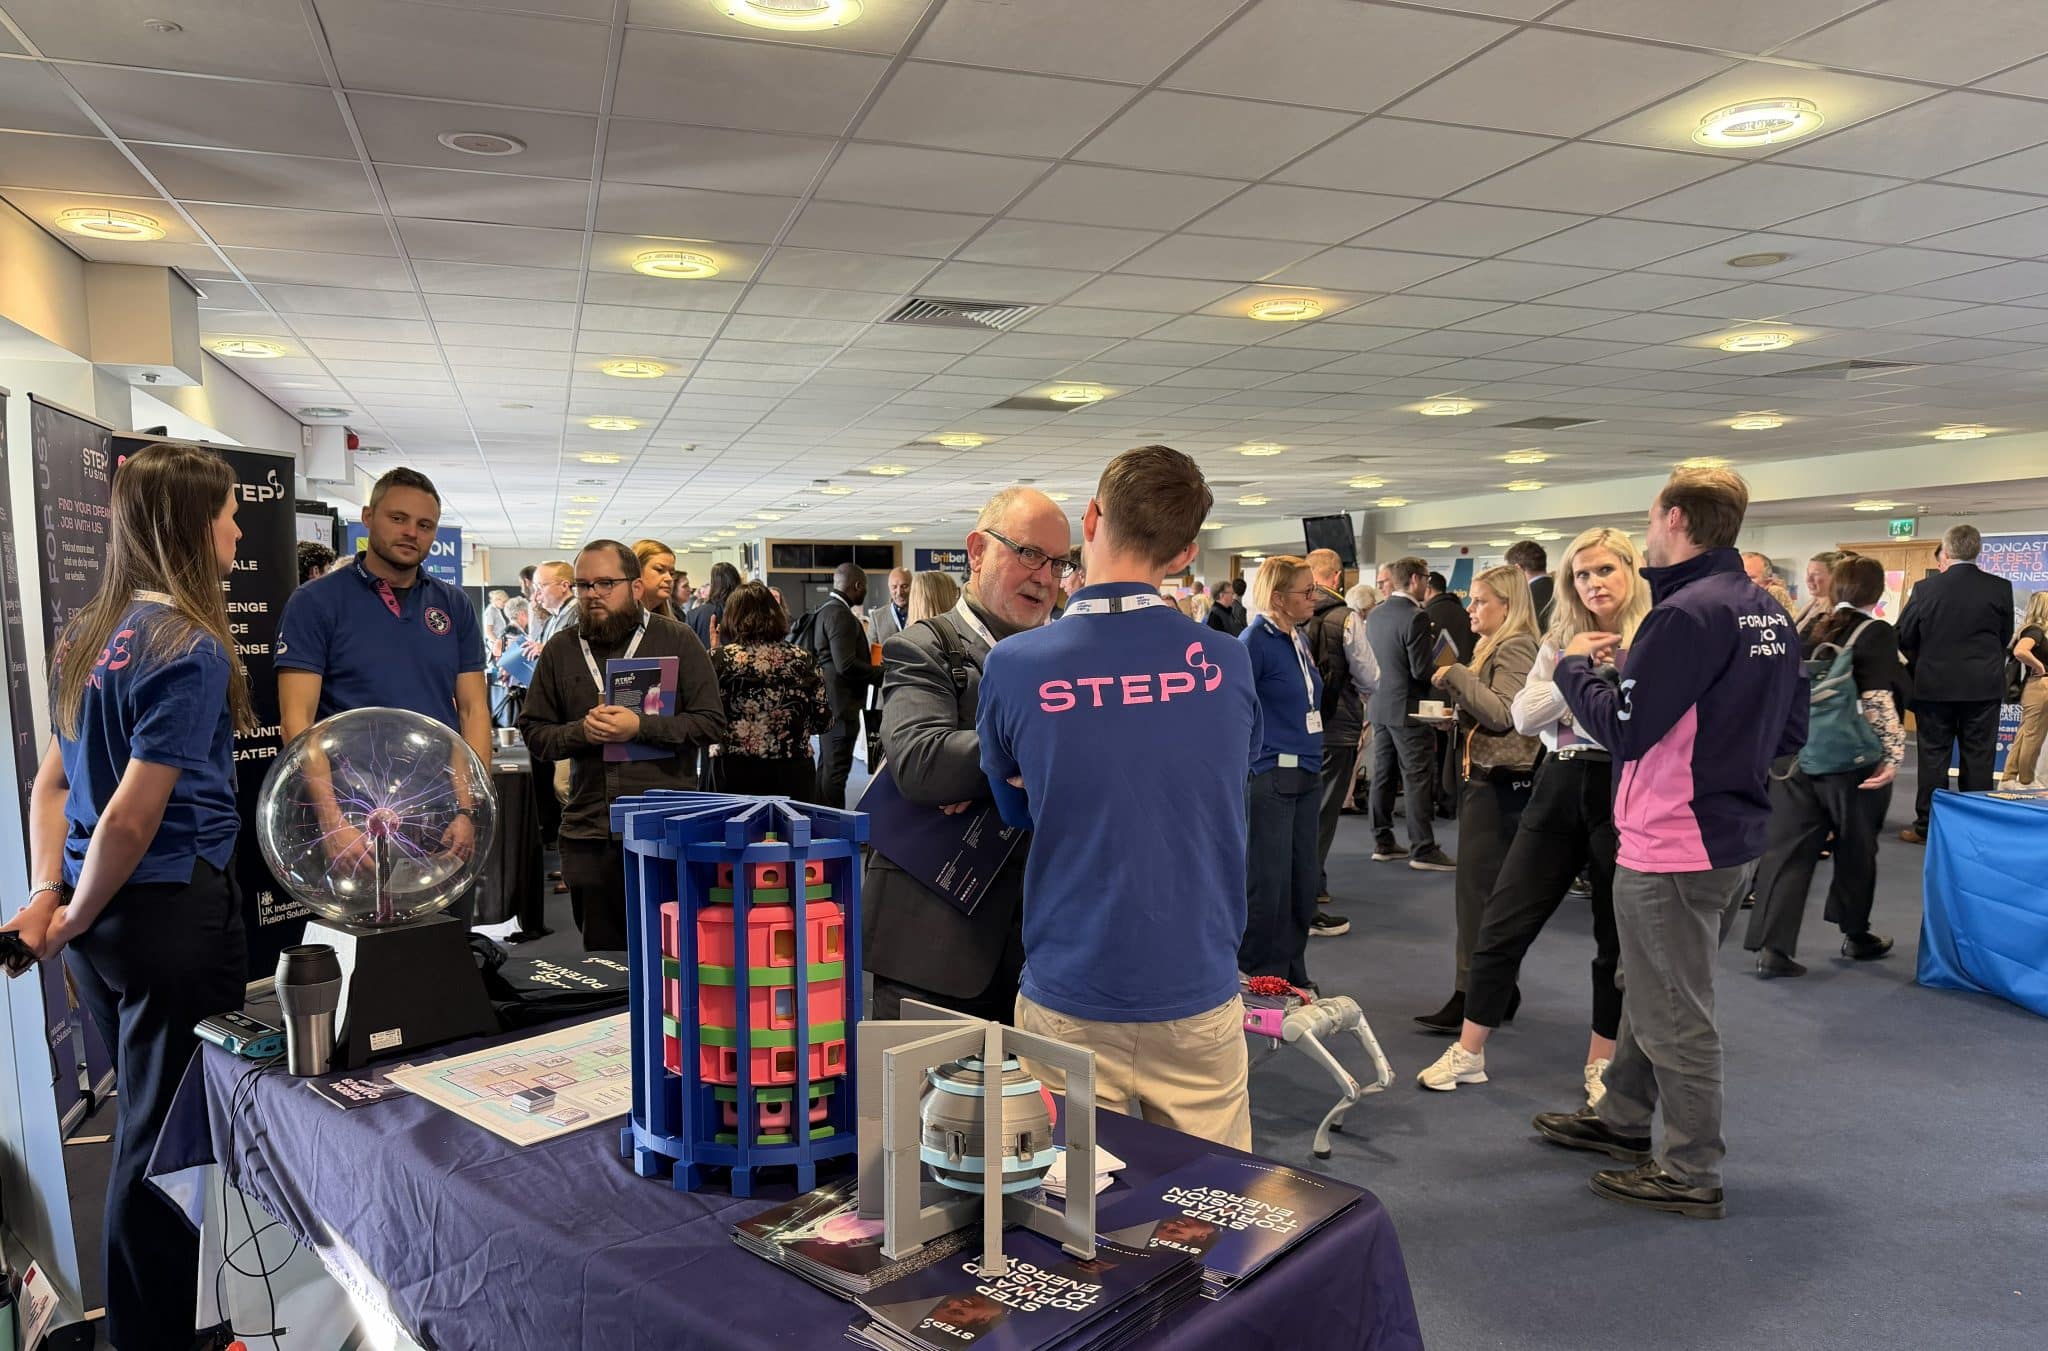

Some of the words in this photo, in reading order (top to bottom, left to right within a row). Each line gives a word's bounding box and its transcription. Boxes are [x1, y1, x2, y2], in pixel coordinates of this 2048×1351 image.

[36, 411, 49, 489] US?
[74, 501, 92, 515] YOUR
[74, 518, 91, 532] WITH
[44, 504, 60, 583] FOR
[1980, 553, 2004, 562] THE
[2006, 552, 2040, 562] BEST
[2022, 561, 2043, 571] TO
[225, 602, 268, 613] ENGE
[1038, 672, 1196, 713] STEP
[262, 906, 274, 915] UK
[263, 913, 285, 925] Fusion
[286, 908, 313, 919] Solutio
[529, 959, 609, 989] POTENTIAL
[1167, 1186, 1260, 1216] FUSION
[1192, 1186, 1295, 1217] ENERGY
[1161, 1194, 1293, 1234] FORWARD
[1182, 1208, 1248, 1231] STEP
[1264, 1213, 1299, 1229] TO
[1158, 1239, 1202, 1255] STEP
[1006, 1256, 1103, 1292] ENERGY
[975, 1284, 1042, 1312] STEP
[1065, 1290, 1101, 1304] TO
[933, 1320, 975, 1341] STEP
